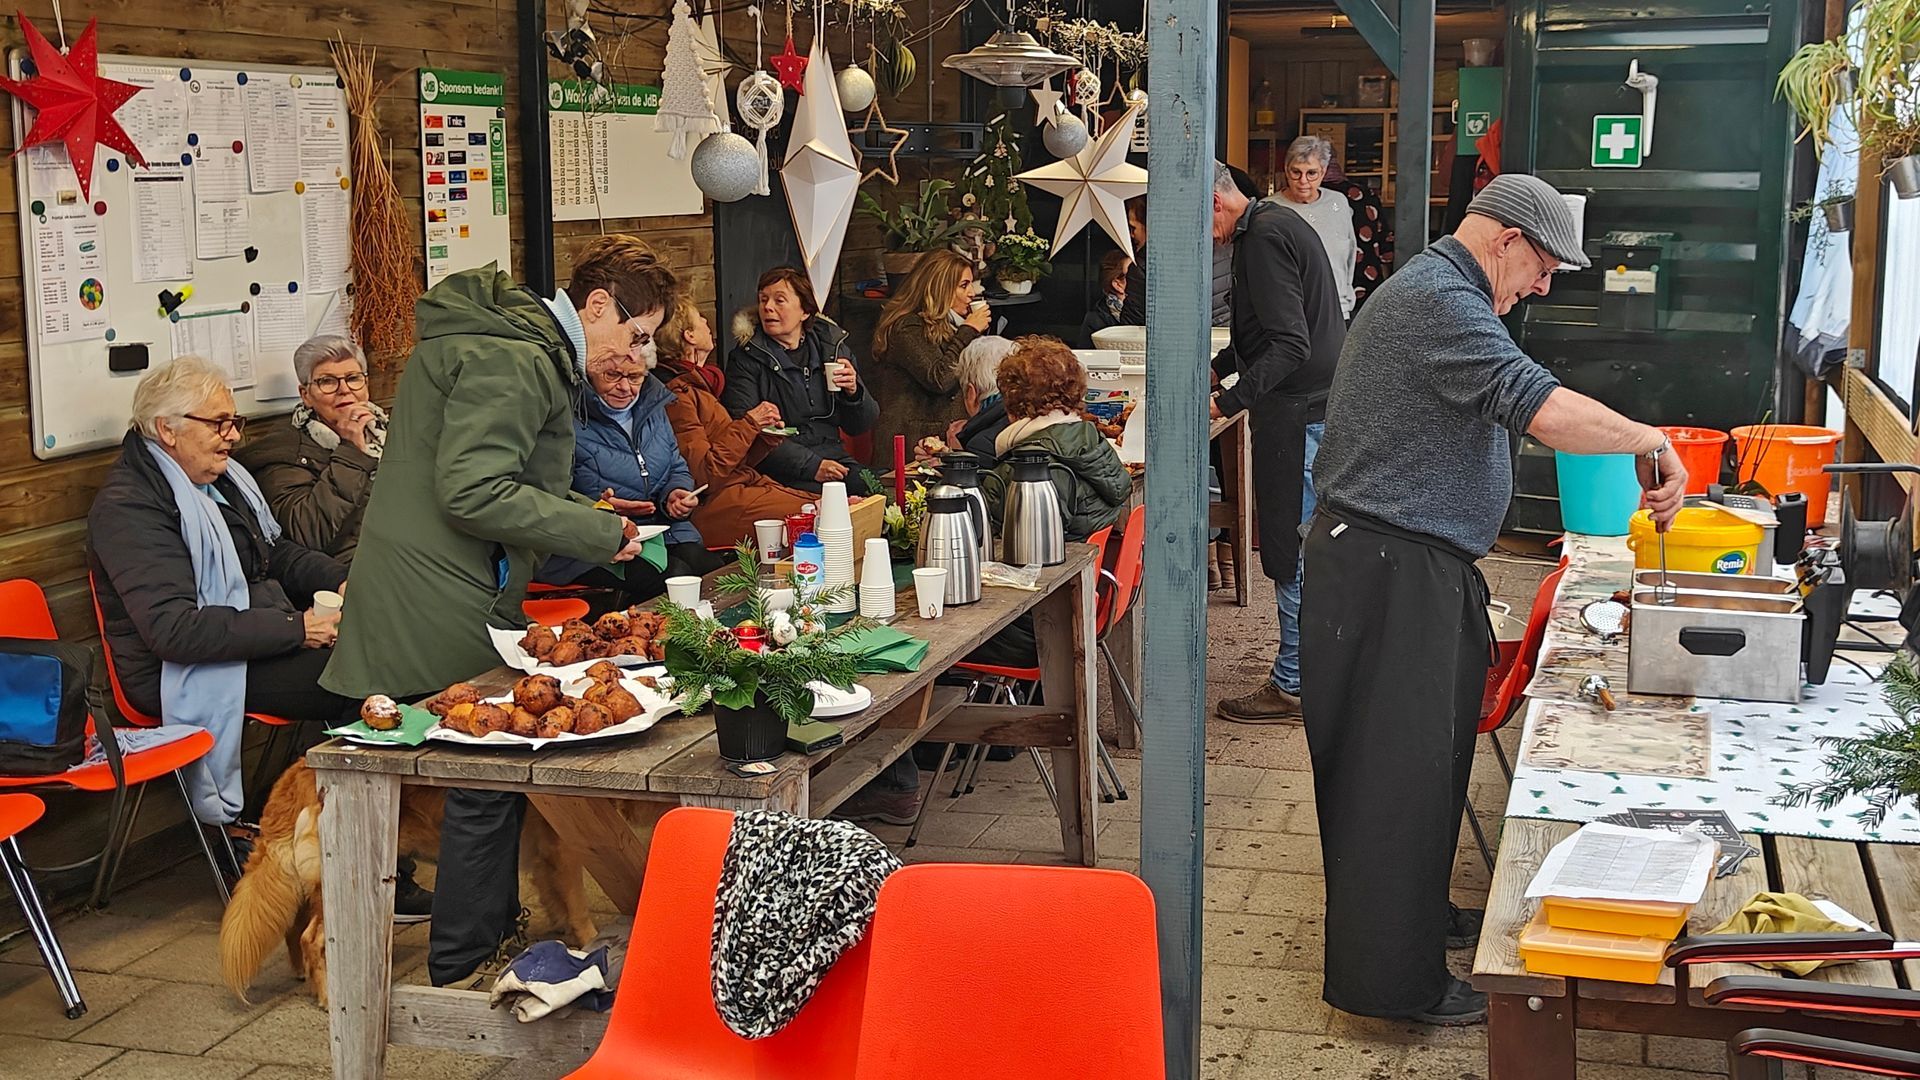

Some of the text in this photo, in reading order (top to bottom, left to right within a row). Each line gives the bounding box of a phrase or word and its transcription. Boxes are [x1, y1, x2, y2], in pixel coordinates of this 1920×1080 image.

[439, 80, 473, 96] Sponsors
[631, 92, 642, 107] de
[642, 93, 658, 107] JdB
[1717, 559, 1744, 571] Remia
